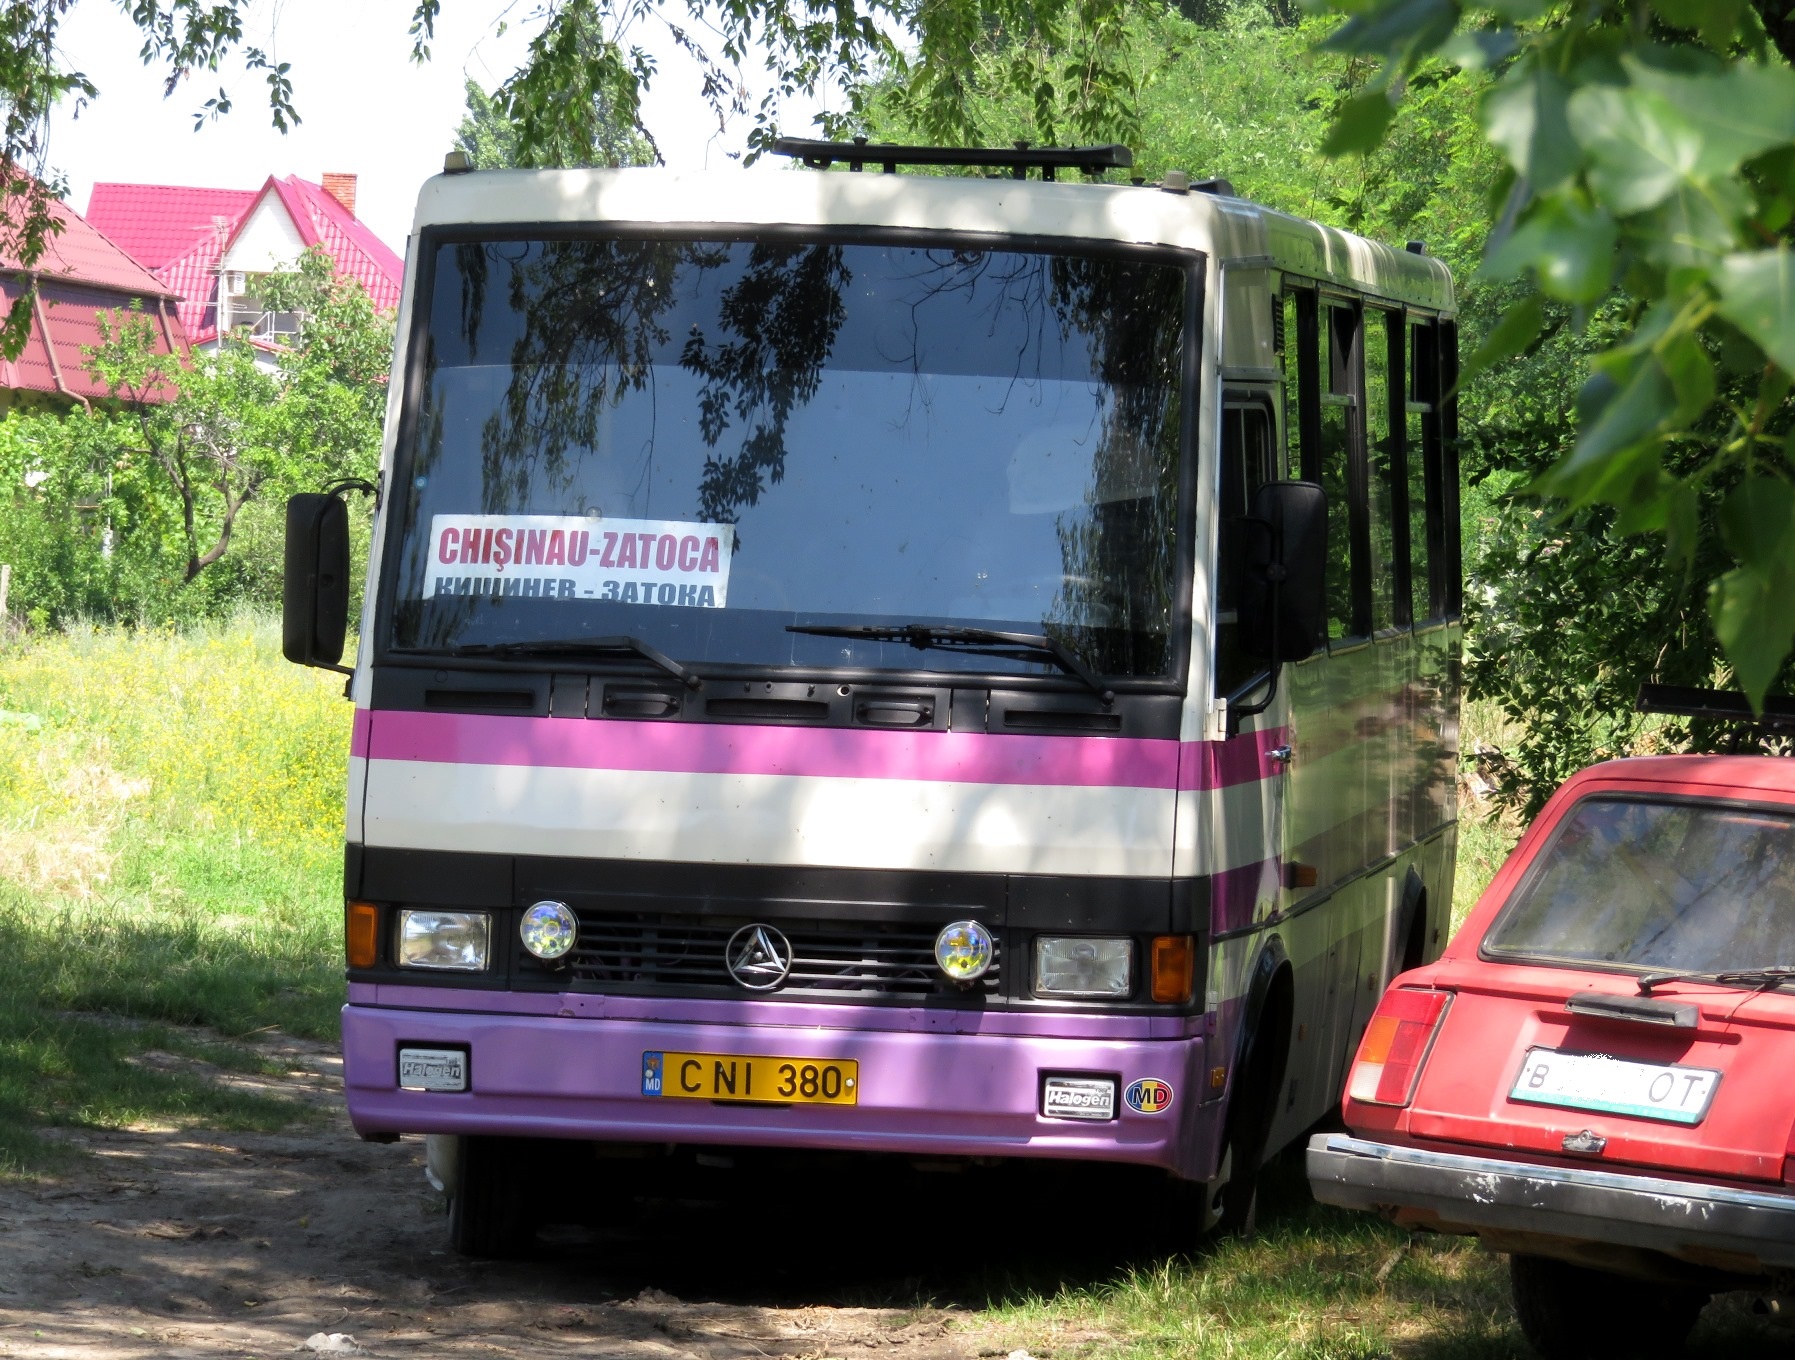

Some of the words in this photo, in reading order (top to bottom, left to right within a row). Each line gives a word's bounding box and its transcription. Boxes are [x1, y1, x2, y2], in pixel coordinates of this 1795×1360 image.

[601, 580, 716, 607] ЗАТОКА
[645, 1077, 661, 1091] MD
[777, 1063, 842, 1099] 380
[1048, 1090, 1110, 1107] Halogen
[1132, 1086, 1168, 1105] MD
